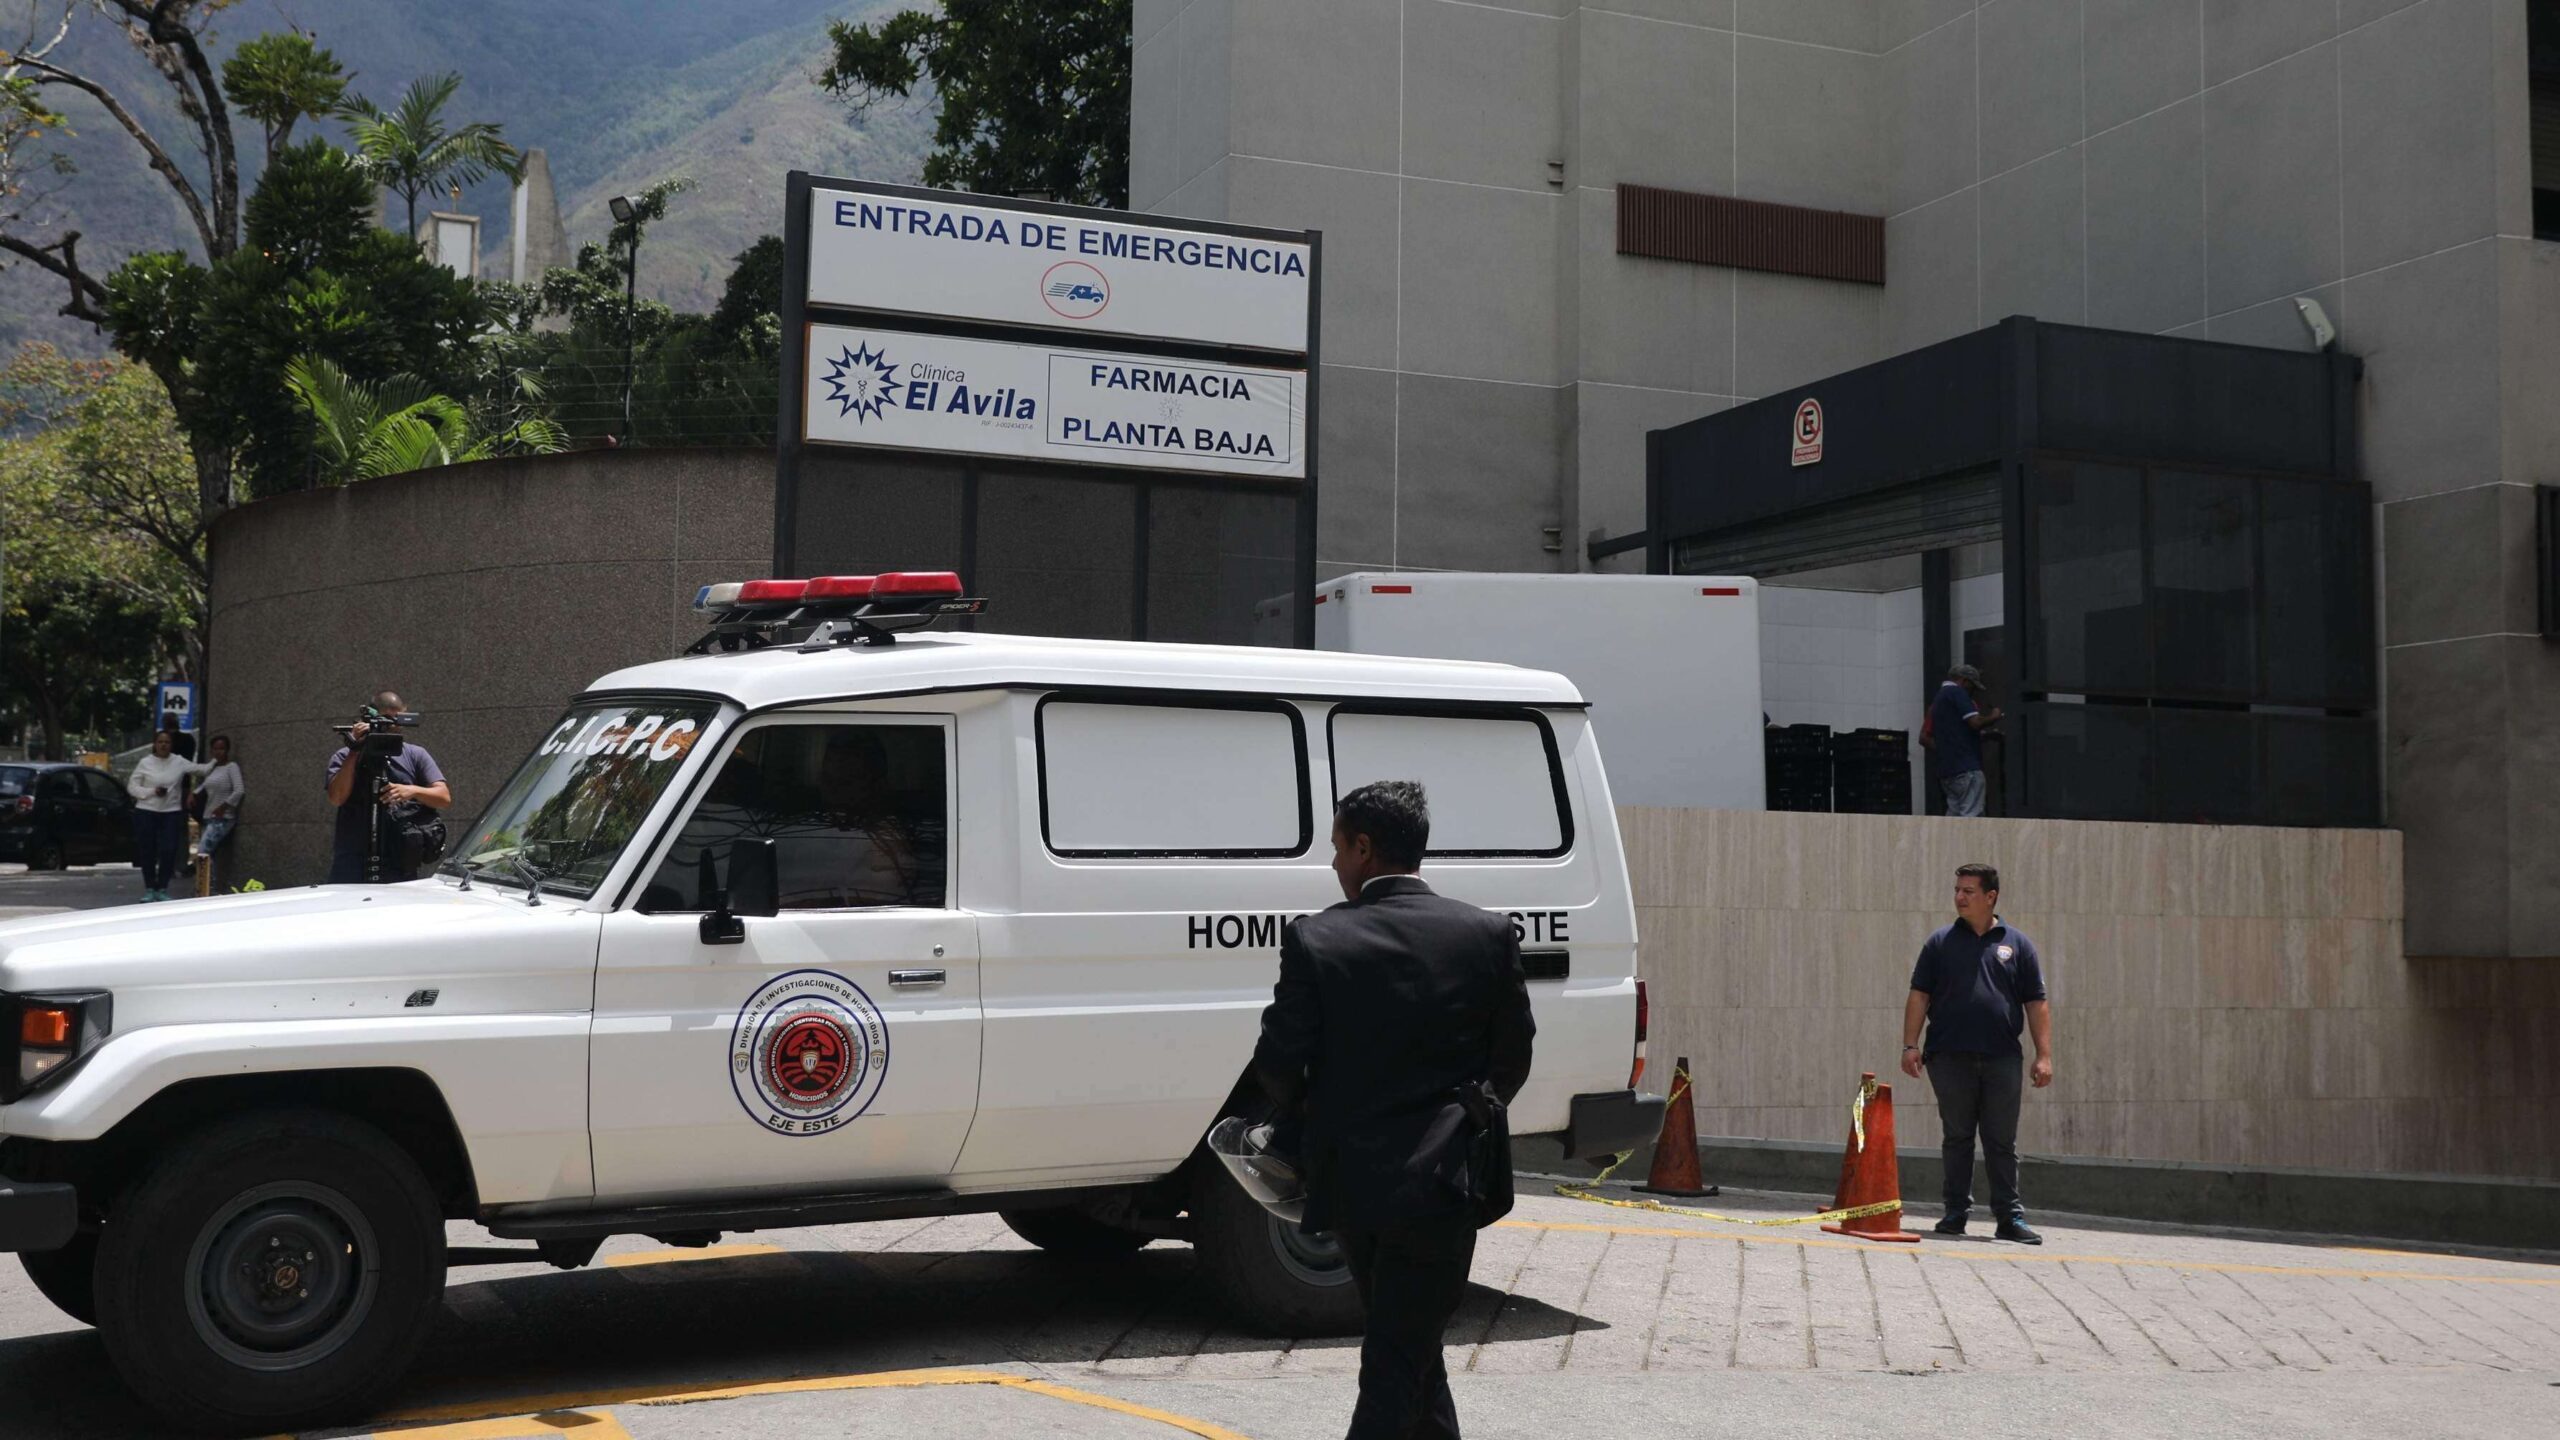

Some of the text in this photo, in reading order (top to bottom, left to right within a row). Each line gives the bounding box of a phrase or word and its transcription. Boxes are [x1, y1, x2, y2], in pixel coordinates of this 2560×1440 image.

[835, 200, 1306, 277] ENTRADA DE EMERGENCIA
[905, 380, 1036, 420] El Avila
[1091, 364, 1251, 401] FARMACIA
[1063, 416, 1275, 457] PLANTA BAJA
[1188, 914, 1309, 949] HOMI
[1507, 911, 1570, 943] STE
[756, 999, 767, 1009] DE
[766, 980, 840, 1000] INVESTIGACIONES
[841, 990, 851, 999] DE
[851, 998, 879, 1044] HOMICIDIOS
[788, 1090, 829, 1102] HOMICIDIOS
[768, 1113, 841, 1132] EJE ESTE
